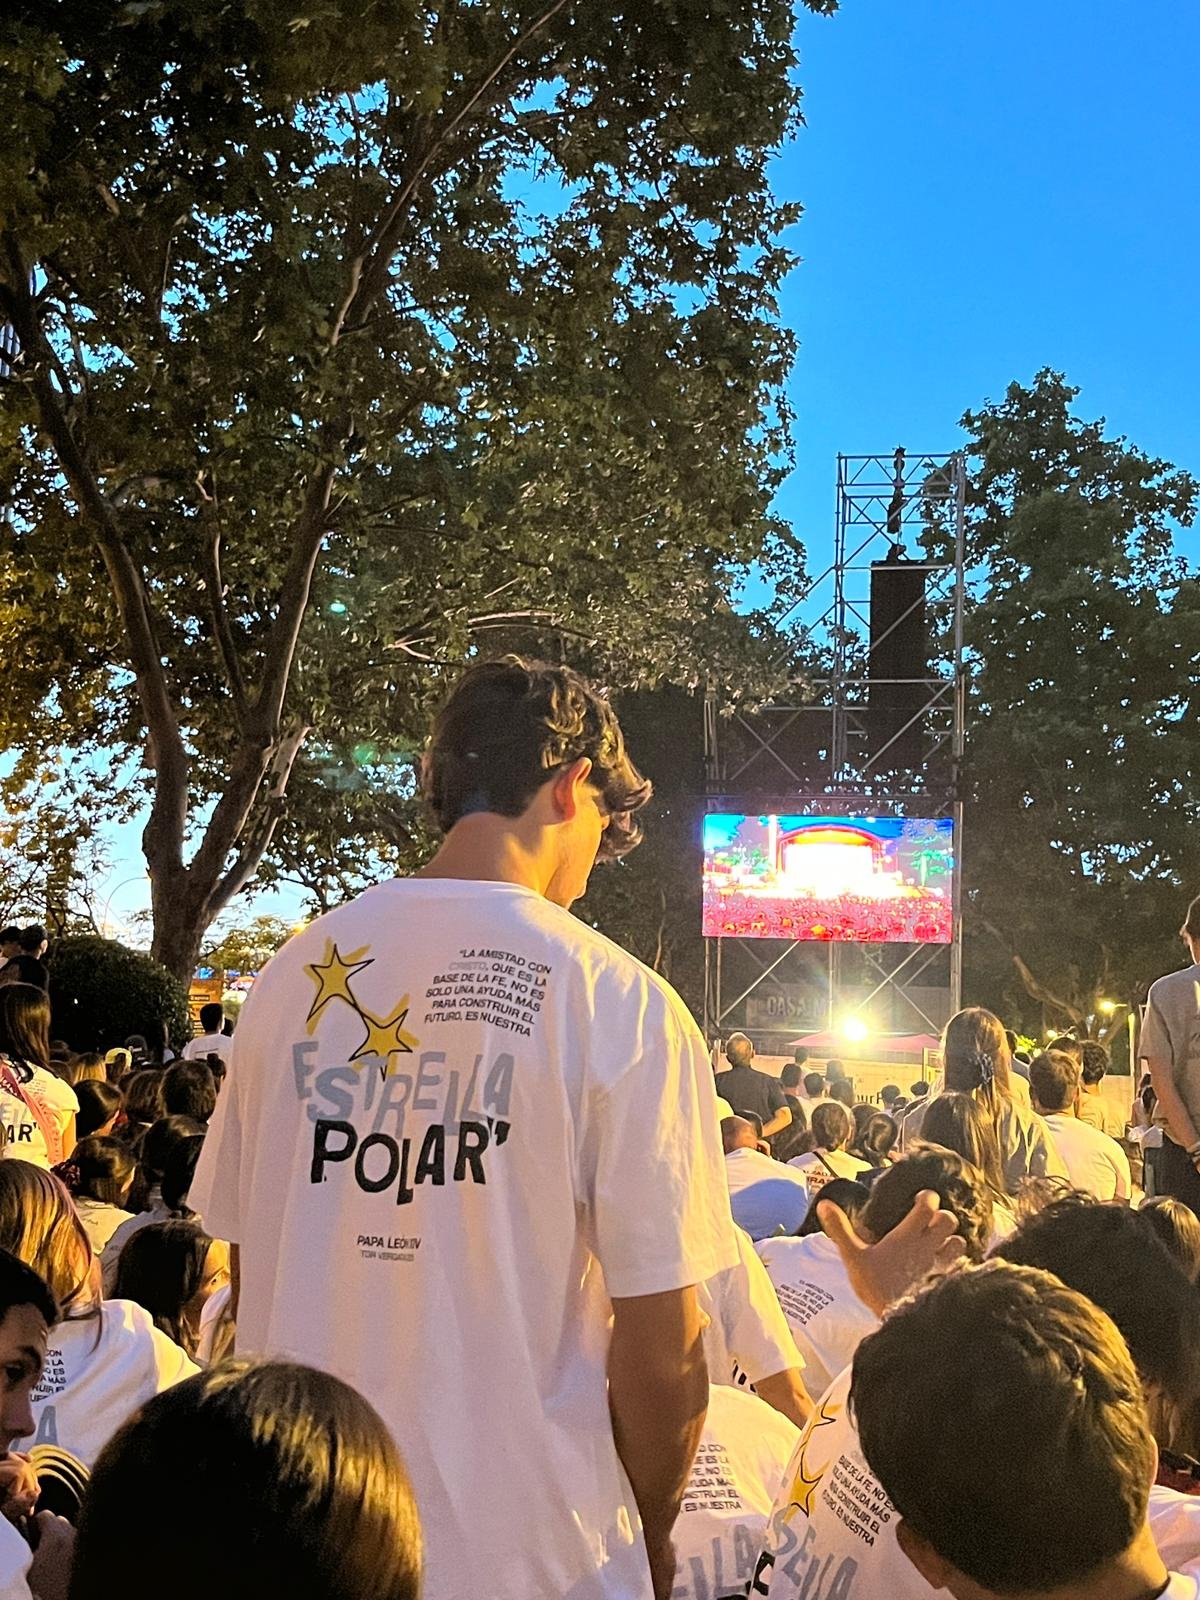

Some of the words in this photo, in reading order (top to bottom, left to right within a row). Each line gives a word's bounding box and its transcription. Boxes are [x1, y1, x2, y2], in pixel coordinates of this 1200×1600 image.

[478, 949, 526, 966] AMISTAD
[528, 962, 552, 974] CON
[433, 973, 459, 984] BASE
[460, 973, 475, 982] DE
[476, 974, 489, 983] LA
[510, 980, 528, 993] NO
[530, 989, 545, 1000] ES
[491, 962, 515, 976] QUE
[517, 970, 533, 982] ES
[534, 977, 547, 987] LA
[426, 987, 452, 998] SOLO
[454, 985, 475, 995] UNA
[477, 986, 513, 1001] AYUDA
[515, 995, 541, 1012] MÁS
[432, 998, 457, 1009] PARA
[458, 997, 520, 1018] CONSTRUIR
[521, 1011, 535, 1025] EL
[465, 1011, 478, 1021] ES
[480, 1012, 531, 1037] NUESTRA
[292, 1041, 515, 1140] ESTRELLA
[357, 1235, 384, 1248] PAPA
[53, 1367, 66, 1375] ES
[728, 1489, 740, 1498] EL
[850, 1485, 871, 1508] AYUDA
[869, 1502, 891, 1523] MÁS
[871, 1487, 886, 1501] NO
[842, 1513, 875, 1547] NUESTRA
[869, 1520, 880, 1535] EL
